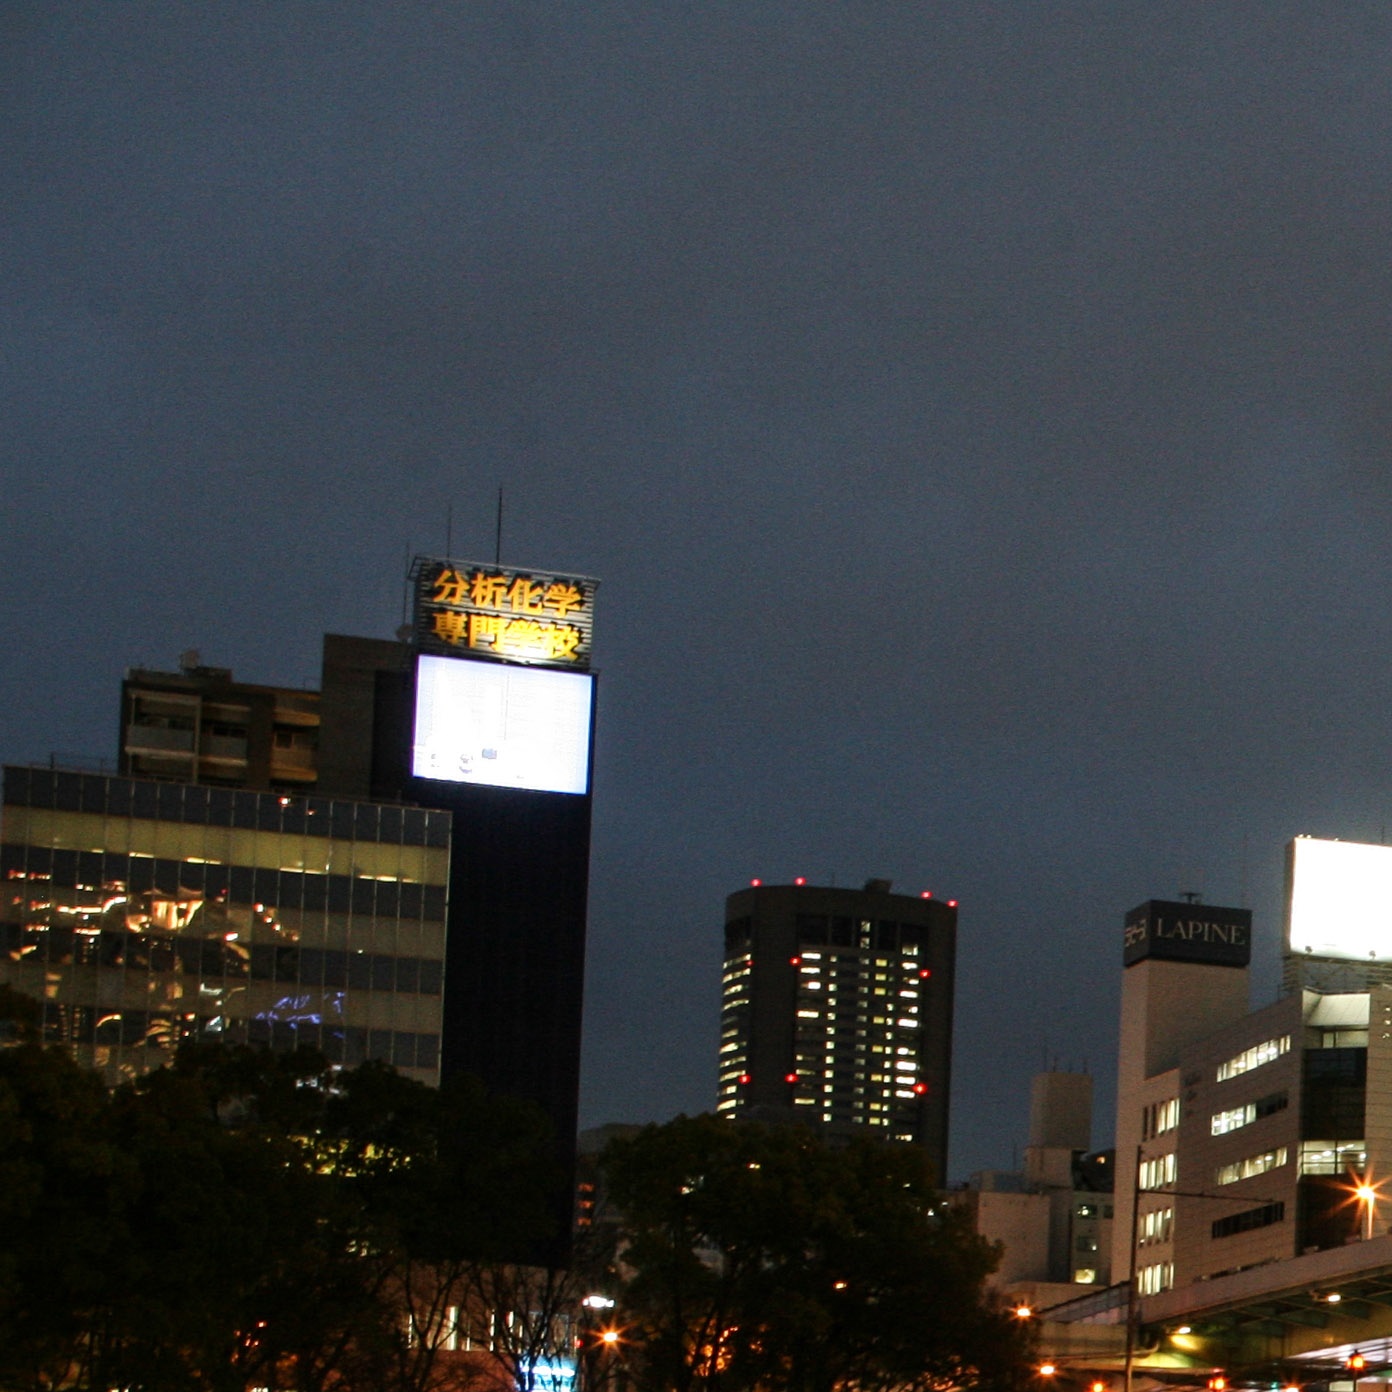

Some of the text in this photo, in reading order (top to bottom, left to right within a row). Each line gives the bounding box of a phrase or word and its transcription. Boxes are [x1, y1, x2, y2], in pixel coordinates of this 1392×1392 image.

[432, 568, 583, 618] 分析化学
[432, 611, 581, 661] 専門学校
[1156, 917, 1245, 945] LAPINE
